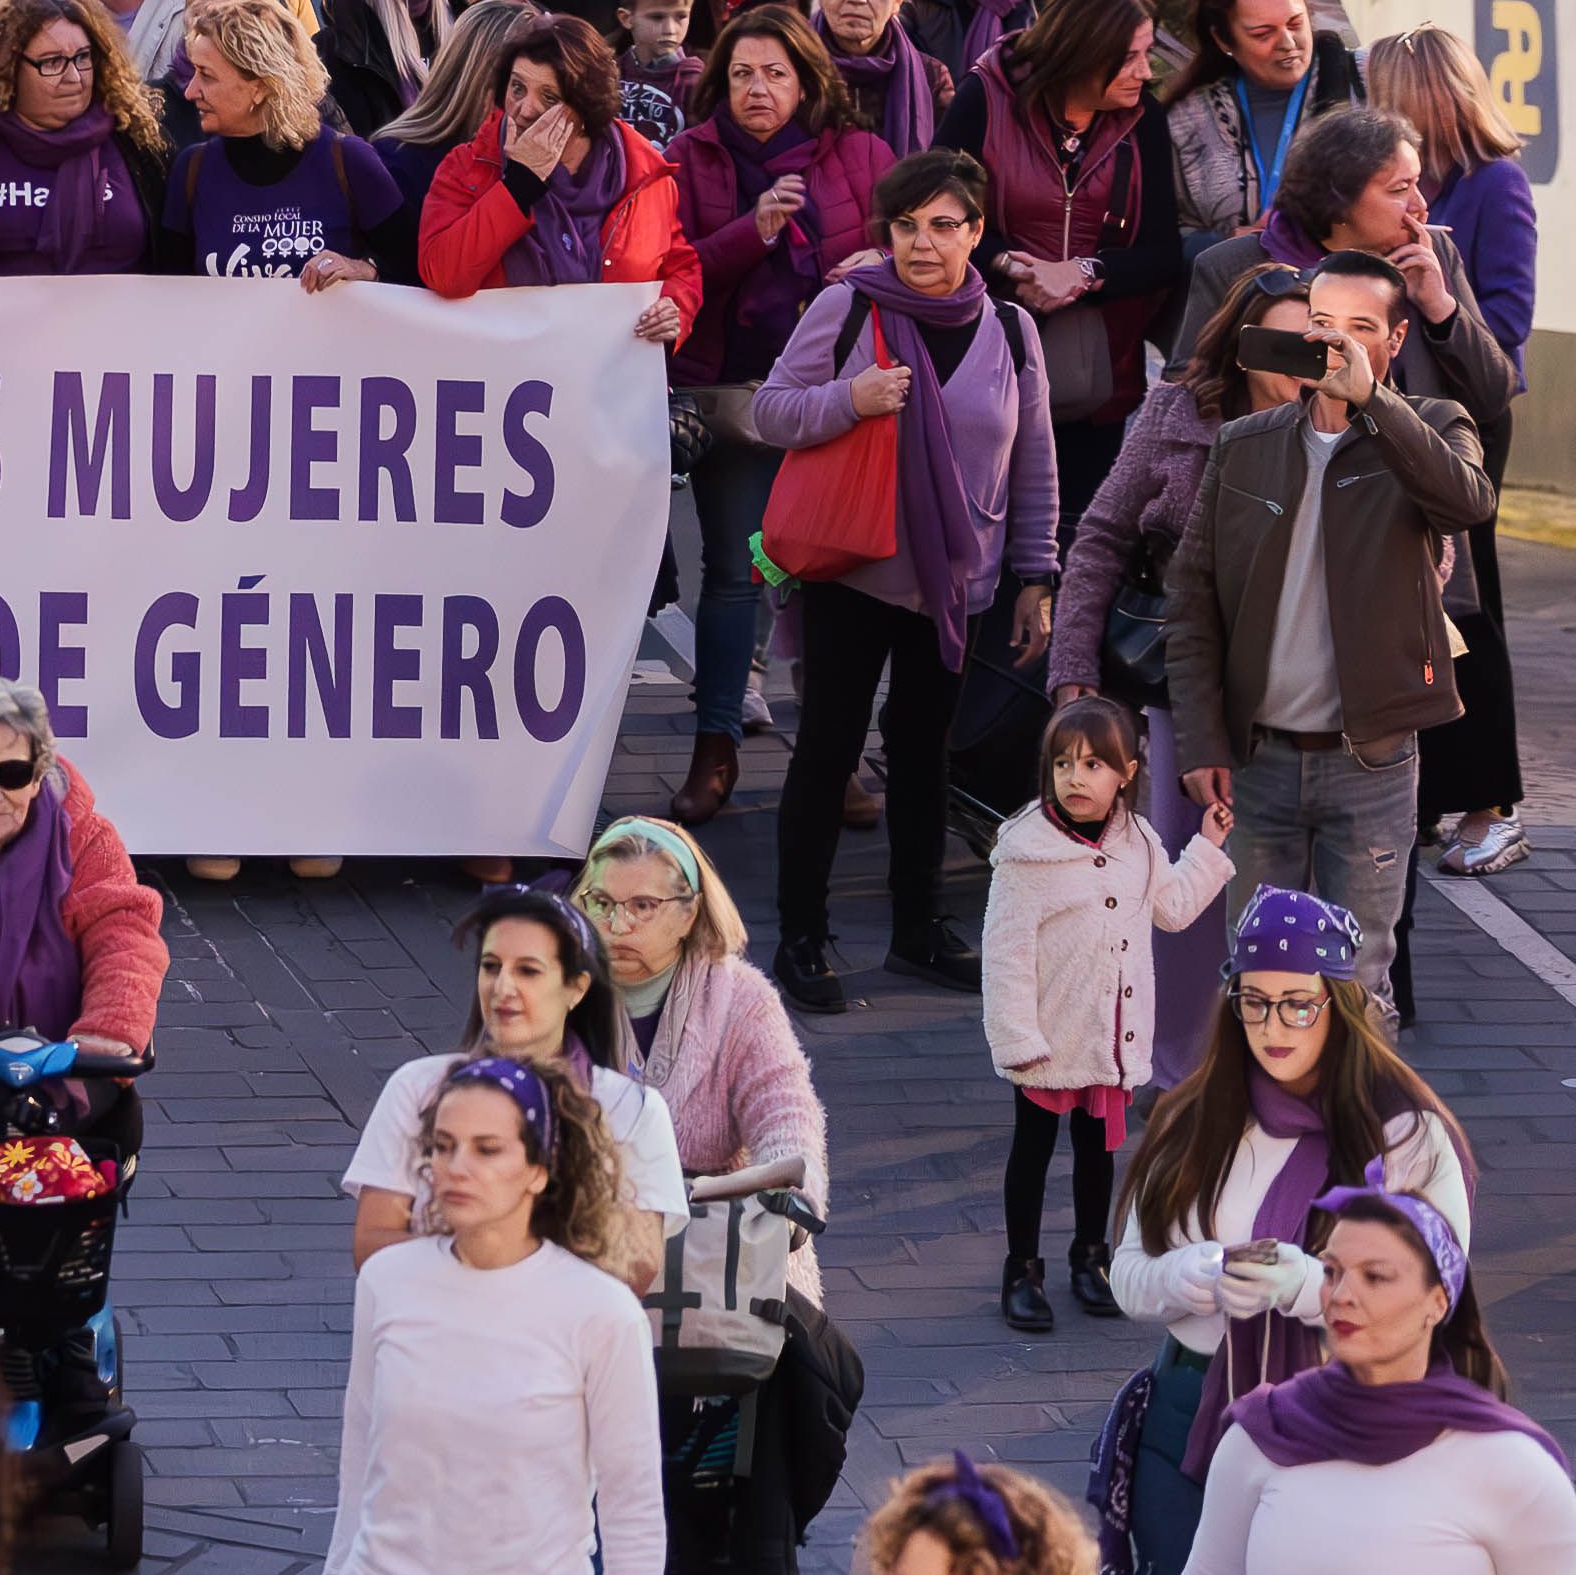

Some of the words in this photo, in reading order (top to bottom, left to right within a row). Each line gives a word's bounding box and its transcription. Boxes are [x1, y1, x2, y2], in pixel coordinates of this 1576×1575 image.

[232, 223, 245, 233] DE
[248, 222, 261, 233] LA
[263, 220, 324, 238] MUJER
[46, 370, 556, 529] MUJERES
[134, 574, 587, 743] GÉNERO
